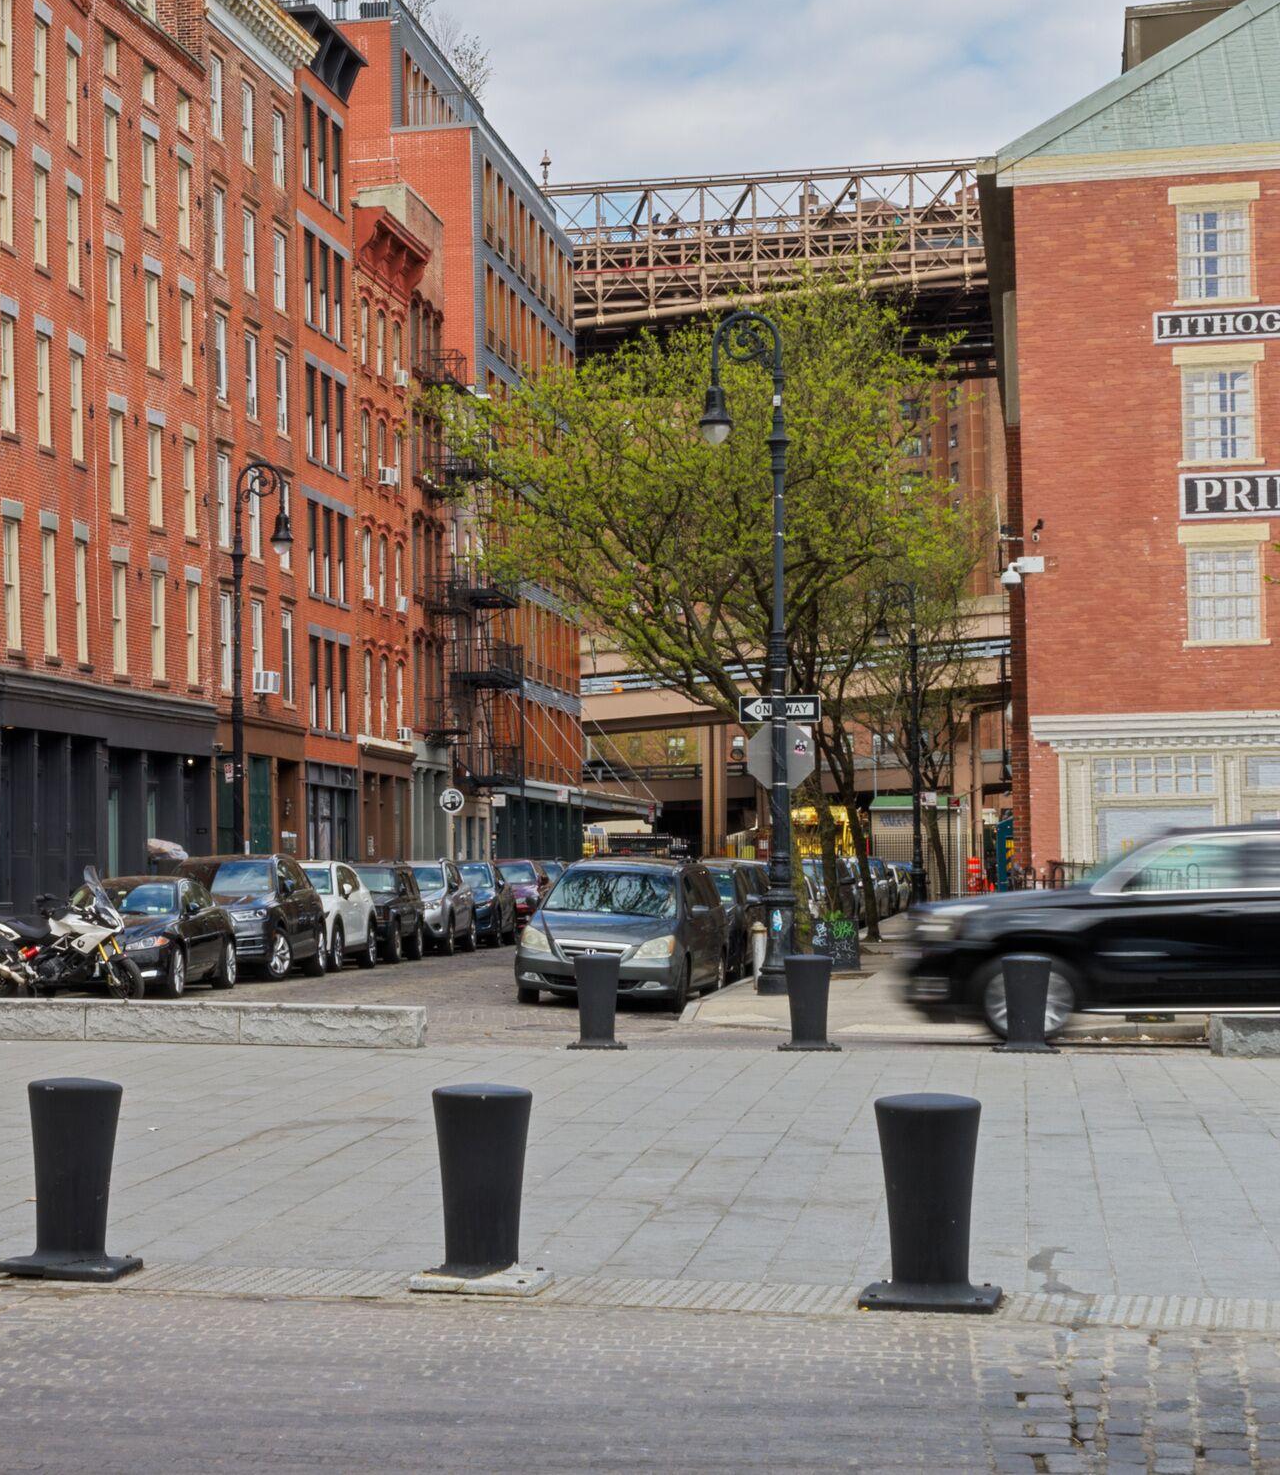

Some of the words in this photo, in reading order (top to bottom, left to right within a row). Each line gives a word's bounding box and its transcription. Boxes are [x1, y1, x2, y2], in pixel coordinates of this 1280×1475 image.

[1194, 476, 1280, 513] PRI
[754, 705, 771, 715] ON
[785, 704, 808, 714] WAY
